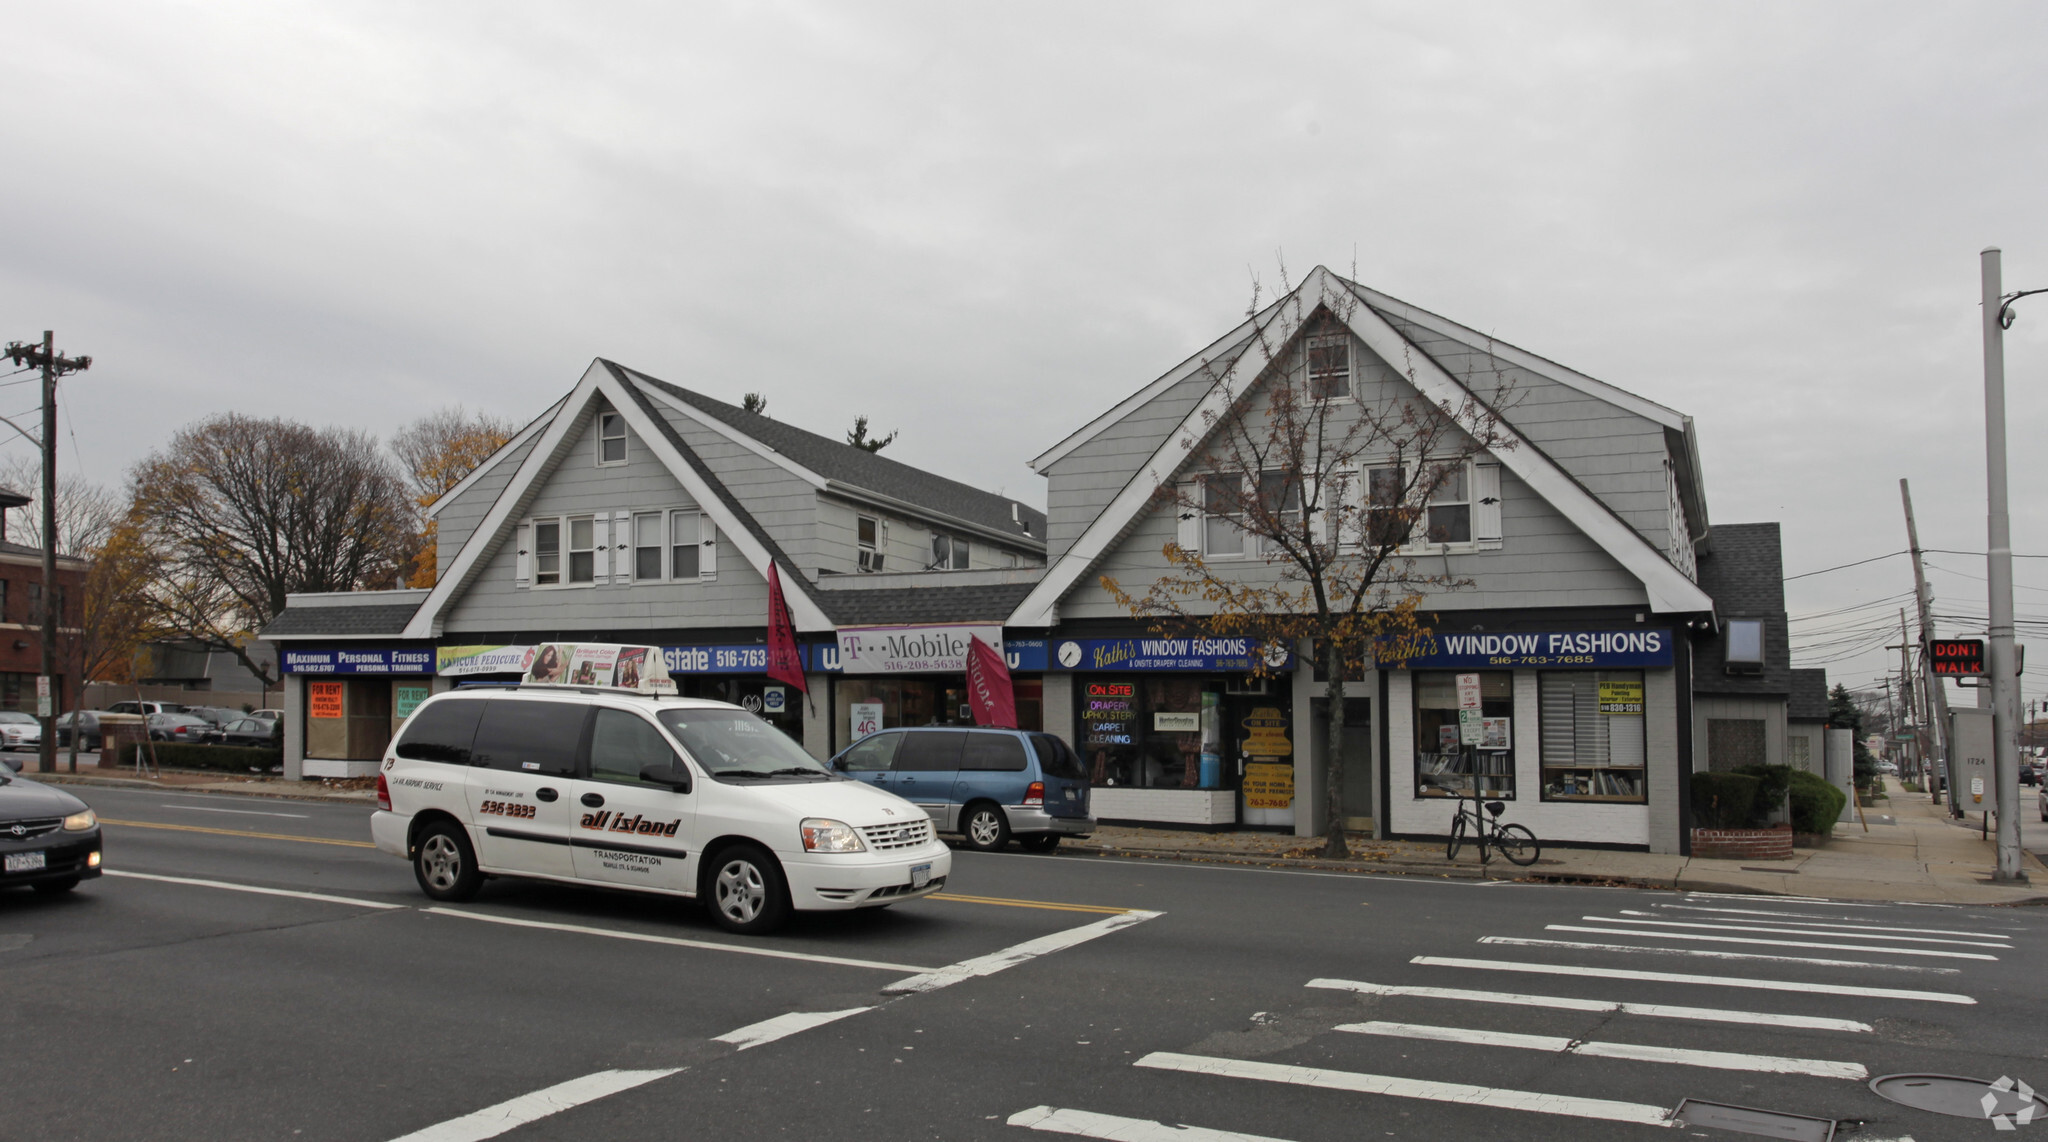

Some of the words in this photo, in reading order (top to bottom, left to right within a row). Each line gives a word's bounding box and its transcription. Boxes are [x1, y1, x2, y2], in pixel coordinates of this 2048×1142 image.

[1445, 635, 1539, 655] WINDOW
[1549, 631, 1662, 653] FASHIONS
[1093, 640, 1136, 668] Kathi's
[1142, 639, 1188, 656] WINDOW
[1192, 639, 1246, 656] FASHIONS
[1935, 643, 1978, 656] DONT
[287, 653, 331, 664] MAXIMUM
[338, 651, 384, 663] PERSONAL
[391, 651, 430, 663] FITNESS
[440, 656, 480, 668] MANICURE
[480, 655, 521, 665] PEDICURE
[1489, 655, 1594, 664] 516-763-7685
[356, 664, 389, 672] PERSONAL
[391, 664, 423, 672] TRAINING
[884, 660, 963, 671] 516-208-5638
[1134, 659, 1152, 668] ONSITE
[1153, 659, 1176, 668] DRAPERY
[1178, 659, 1204, 668] CLEANING
[1935, 661, 1981, 673] WALK
[312, 685, 324, 695] FOR
[326, 685, 341, 695] RENT
[1089, 684, 1106, 695] ON
[1108, 685, 1131, 695] SITE
[398, 690, 410, 701] FOR
[411, 690, 428, 701] RENT
[1090, 701, 1130, 710] DRAPERY
[857, 720, 876, 735] 4G
[1092, 723, 1126, 732] CARPET
[1089, 734, 1131, 744] CLEANING
[385, 757, 396, 771] 73
[1967, 758, 1985, 766] 1724
[405, 779, 423, 788] AIRPORT
[423, 781, 443, 791] SERVICE
[1250, 799, 1289, 808] 763-7685
[480, 800, 537, 820] 536-3333
[580, 810, 612, 831] all
[608, 812, 682, 838] island
[593, 850, 662, 866] TRANSPORTATION
